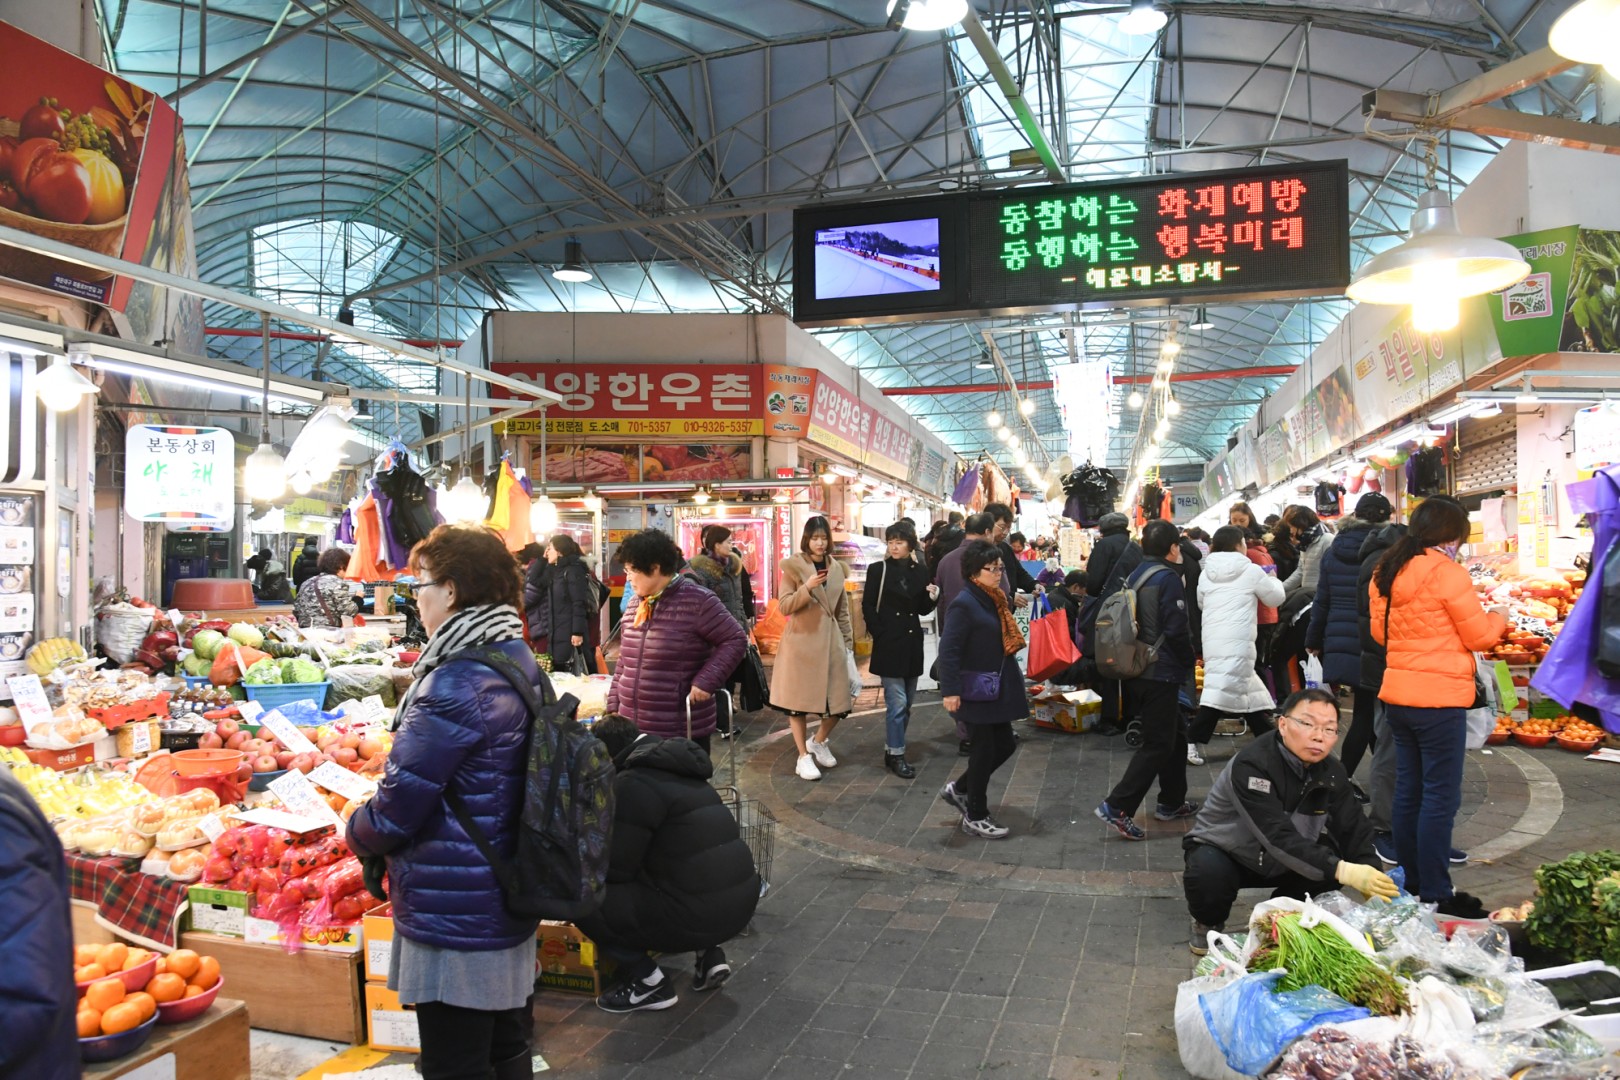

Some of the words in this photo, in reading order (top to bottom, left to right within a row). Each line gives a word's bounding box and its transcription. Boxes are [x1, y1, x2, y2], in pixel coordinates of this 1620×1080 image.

[999, 194, 1139, 235] 동참하는
[1157, 178, 1307, 219] 화재예방
[1000, 231, 1139, 271] 동행하는
[1156, 216, 1303, 259] 행복미래
[556, 421, 583, 433] 전문점
[627, 421, 672, 433] 701-5357
[683, 421, 753, 433] 010-9326-5357
[814, 382, 871, 444] 언양한우촌
[146, 437, 215, 455] 본동상회
